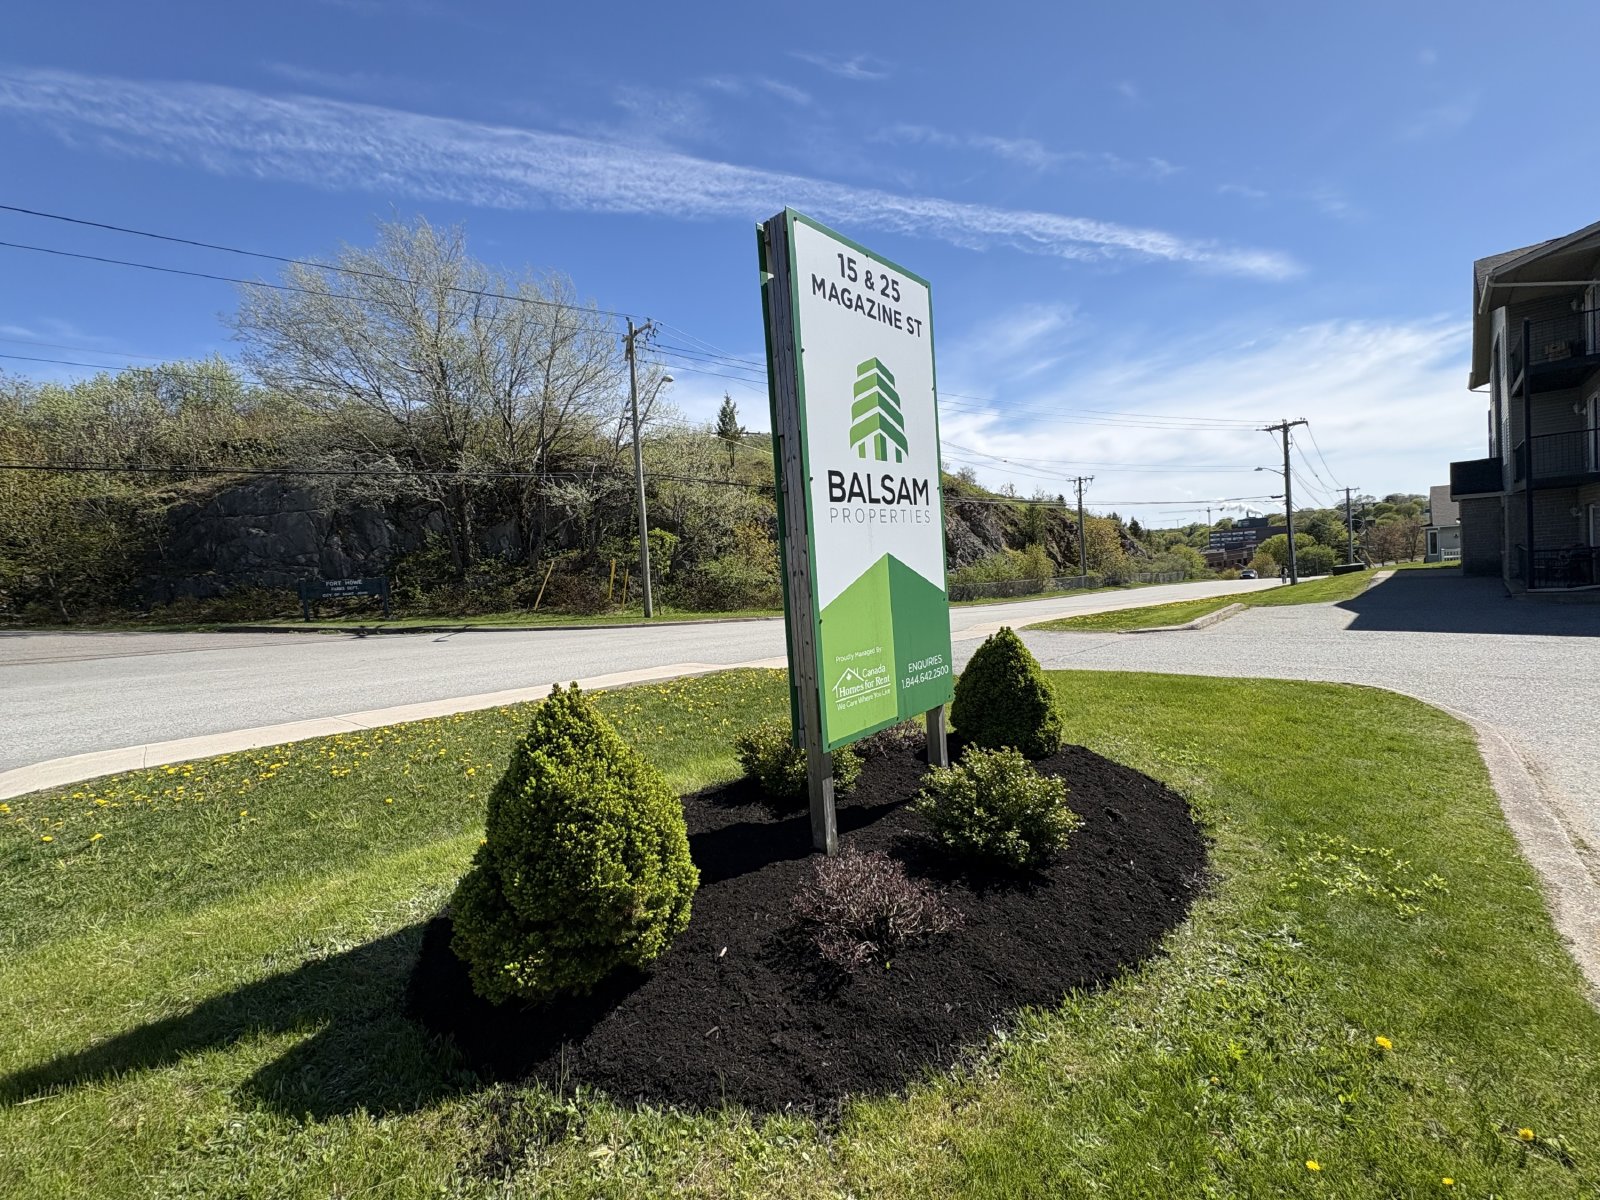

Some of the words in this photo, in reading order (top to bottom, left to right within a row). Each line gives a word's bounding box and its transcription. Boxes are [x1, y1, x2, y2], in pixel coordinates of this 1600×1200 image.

[837, 253, 858, 283] 15
[864, 269, 875, 291] &
[879, 273, 901, 303] 25
[811, 273, 903, 331] MAGAZINE
[906, 316, 923, 338] ST
[827, 469, 930, 506] BALSAM
[829, 507, 931, 524] PROPERTIES
[835, 653, 854, 663] Proudly
[854, 648, 876, 659] Managed
[908, 654, 943, 673] ENQUIRIES
[862, 664, 886, 678] Canada
[901, 664, 949, 689] 1.844.642.2500
[839, 683, 864, 698] Homes
[864, 679, 874, 689] for
[875, 675, 890, 687] Rent
[836, 702, 846, 711] We
[846, 699, 858, 708] Care
[858, 695, 874, 704] Where
